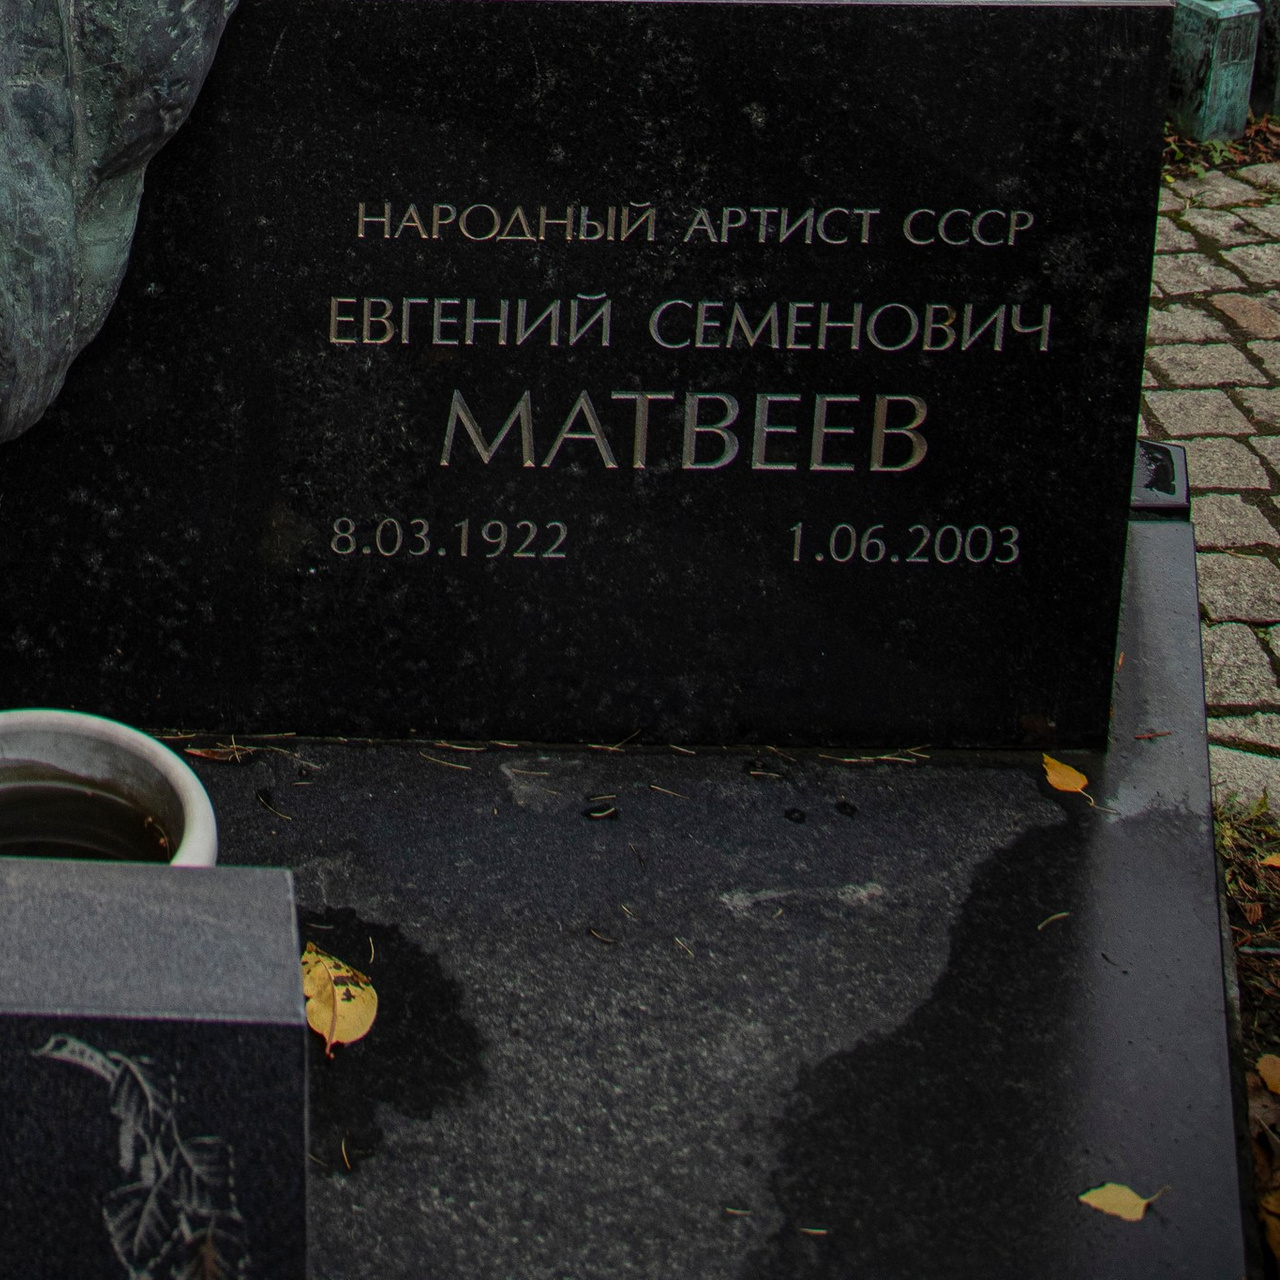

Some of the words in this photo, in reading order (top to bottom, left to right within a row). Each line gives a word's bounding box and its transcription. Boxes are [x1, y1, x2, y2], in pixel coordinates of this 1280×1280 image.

[357, 200, 657, 242] НАРОДНЫЙ
[683, 206, 881, 244] АРТИСТ
[902, 208, 1035, 246] СССР
[329, 292, 613, 346] ЕВГЕНИЙ
[648, 298, 1052, 352] СЕМЕНОВИЧ
[439, 389, 929, 473] МАТВЕЕВ
[330, 517, 569, 559] 8.03.1922
[788, 521, 1022, 564] 1.06.2003
